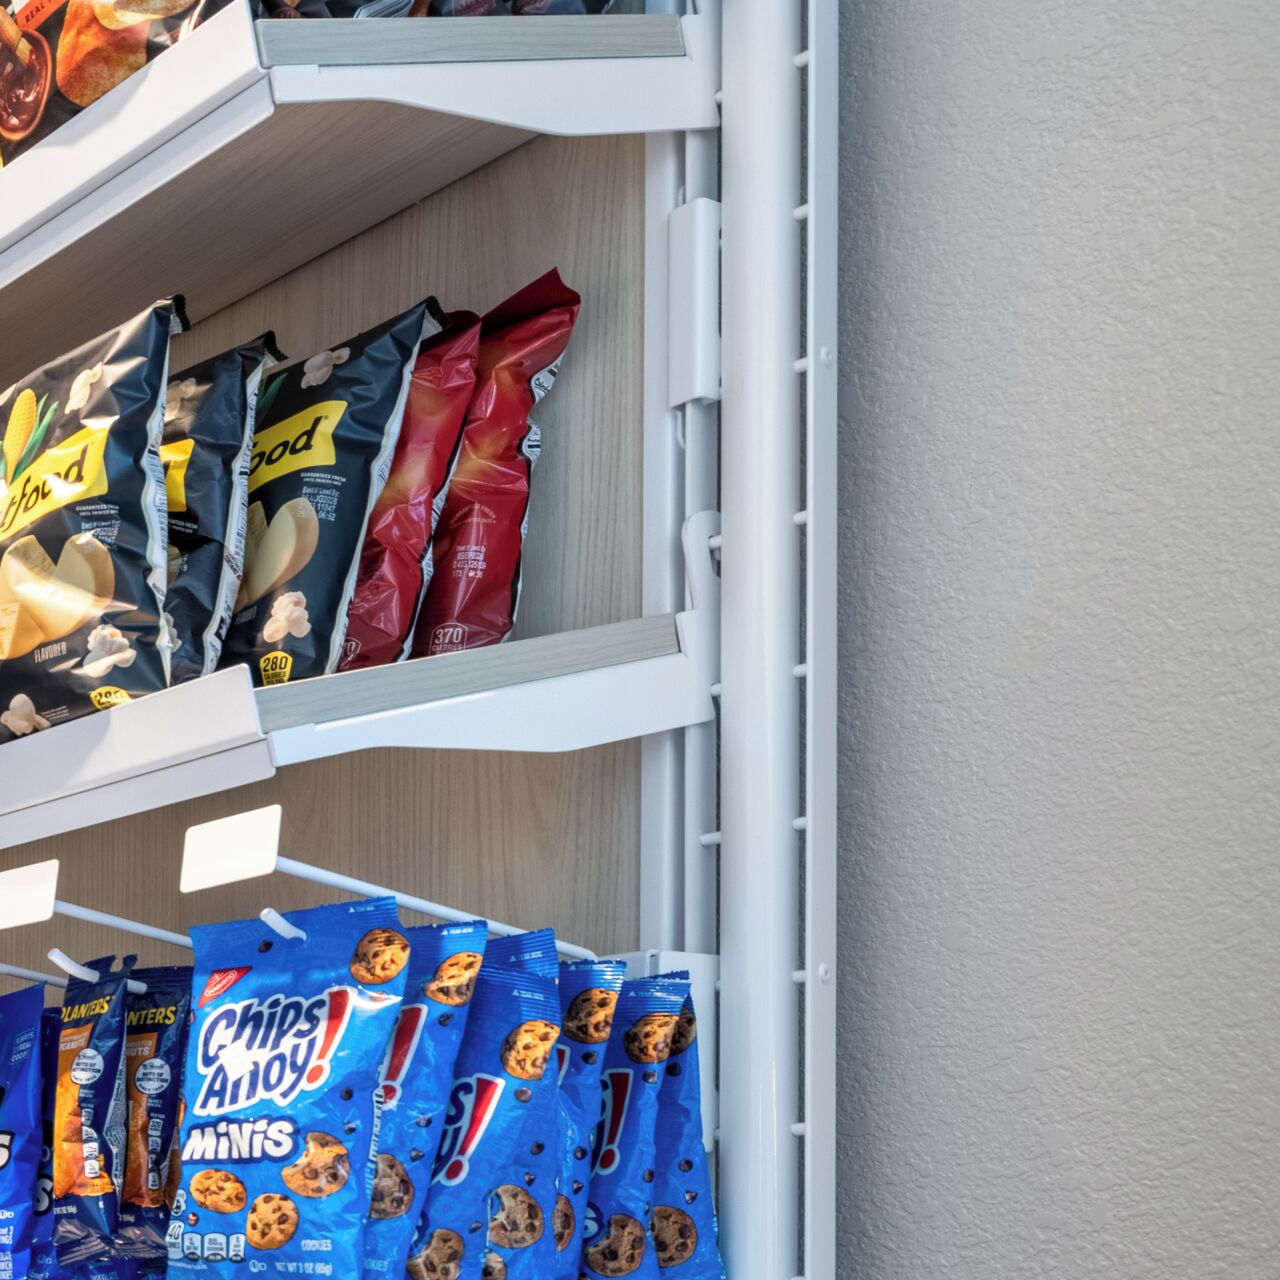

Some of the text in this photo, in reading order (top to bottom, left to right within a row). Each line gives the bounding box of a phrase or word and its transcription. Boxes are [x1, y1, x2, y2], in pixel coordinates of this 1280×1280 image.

[435, 627, 463, 645] 370
[34, 641, 67, 663] FLAVORED
[263, 656, 289, 673] 280
[203, 994, 325, 1066] Chips
[301, 1239, 332, 1251] COOKIES
